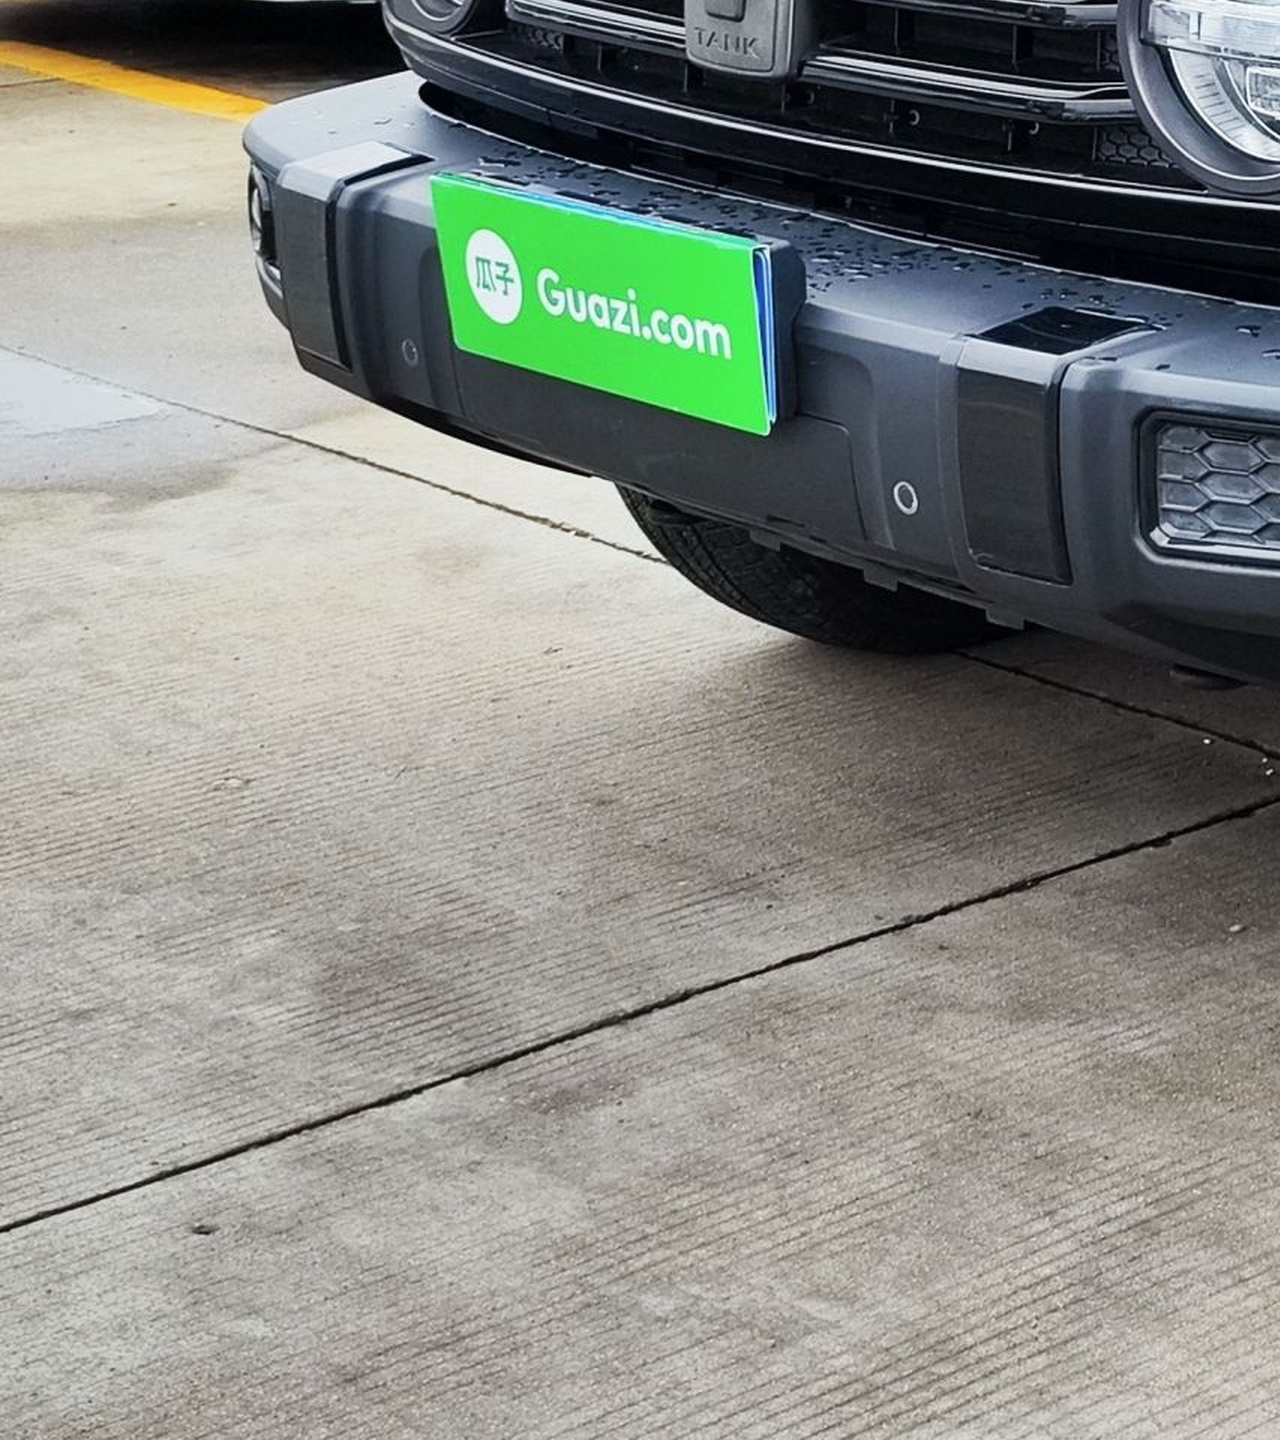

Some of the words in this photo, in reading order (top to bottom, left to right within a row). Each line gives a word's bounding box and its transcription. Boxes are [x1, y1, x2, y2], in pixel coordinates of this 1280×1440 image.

[694, 26, 762, 60] TANK
[475, 256, 515, 296] 瓜子
[536, 267, 733, 360] Guazi.com
